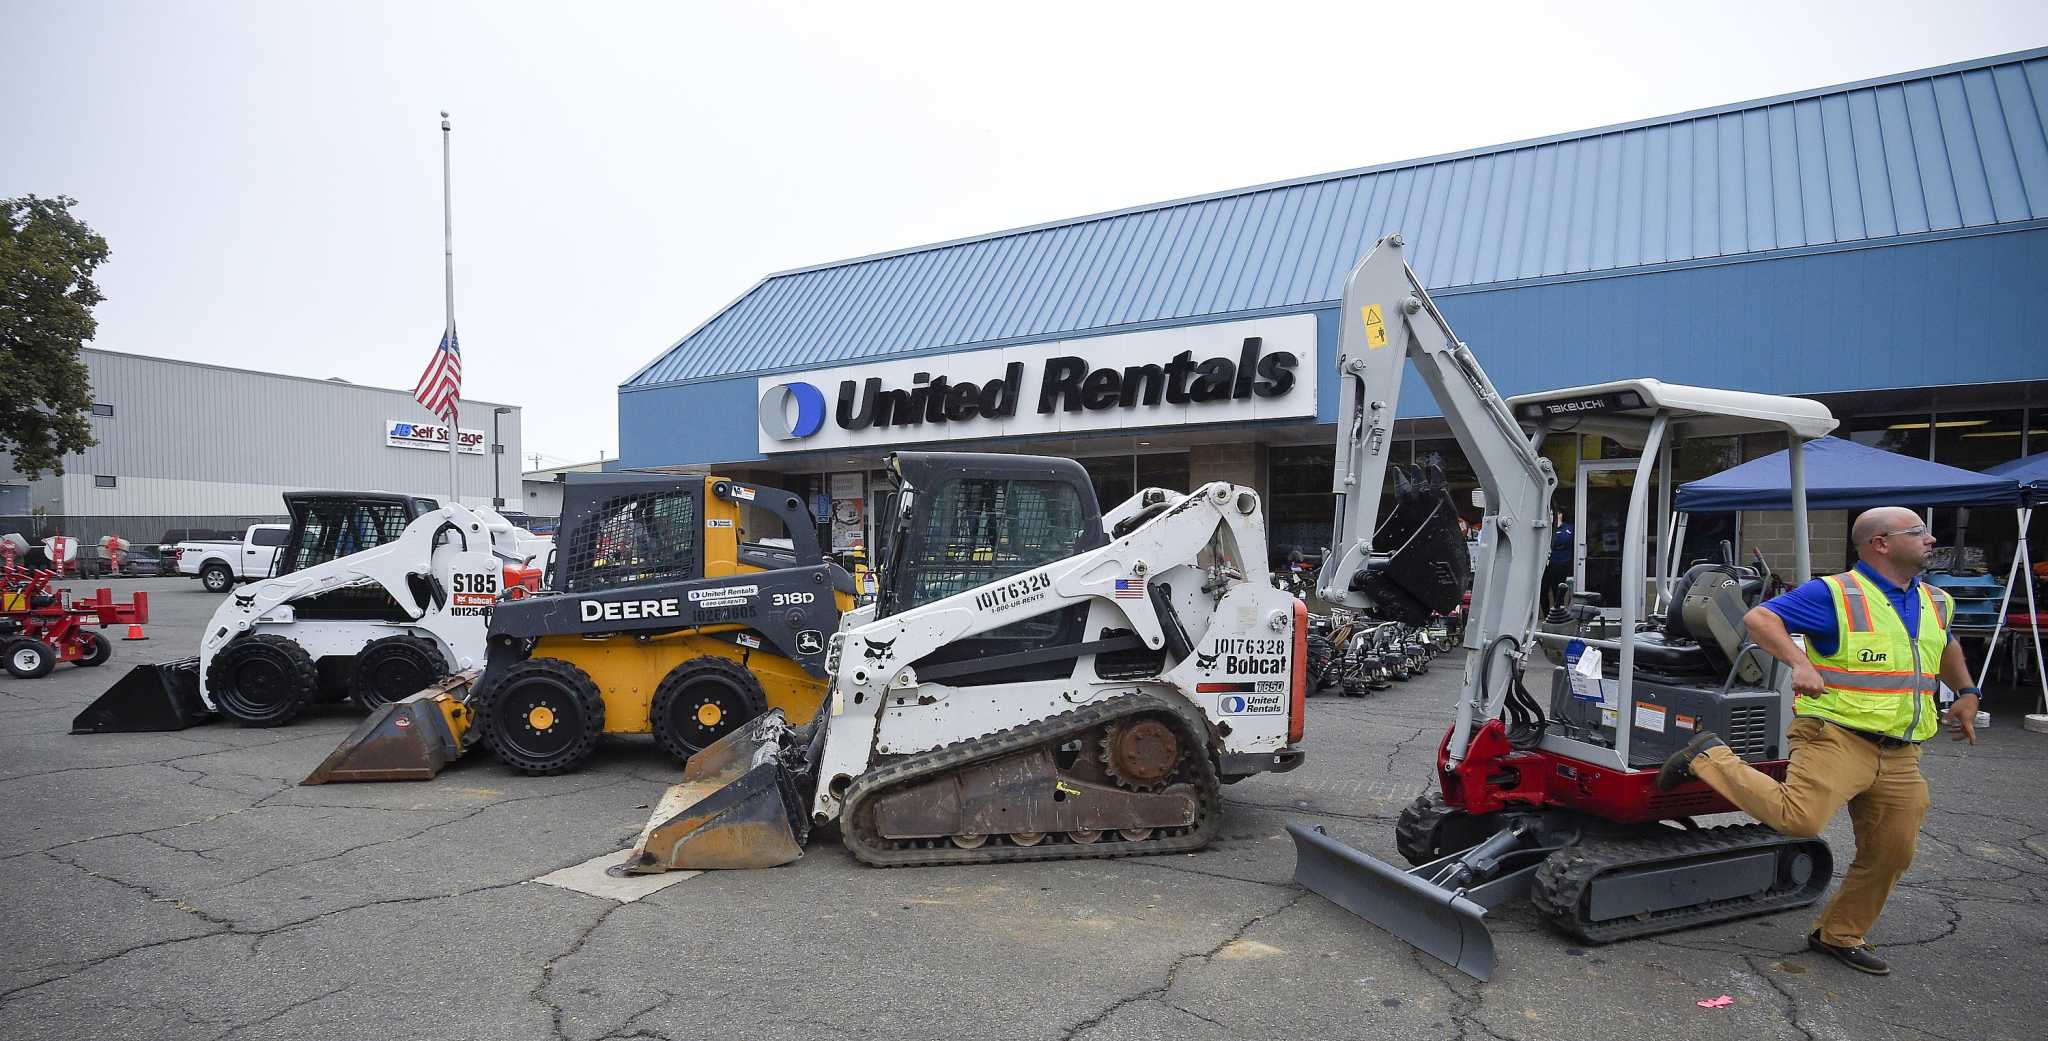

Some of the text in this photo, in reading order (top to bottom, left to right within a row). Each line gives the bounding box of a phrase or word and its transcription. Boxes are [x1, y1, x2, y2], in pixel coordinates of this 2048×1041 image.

[835, 337, 1299, 431] United Rentals
[1546, 399, 1605, 414] TAKEUCHI
[411, 425, 434, 439] Self
[436, 428, 484, 445] Strage
[453, 573, 497, 593] S185
[727, 587, 755, 596] Rentals
[975, 572, 1051, 611] 10176328
[772, 592, 815, 606] 318D
[579, 599, 680, 624] DEERE
[1215, 638, 1285, 655] 10176328
[1226, 655, 1287, 675] Bobcat
[1256, 681, 1285, 693] T650
[1246, 704, 1281, 713] Rentals
[1247, 696, 1279, 705] United
